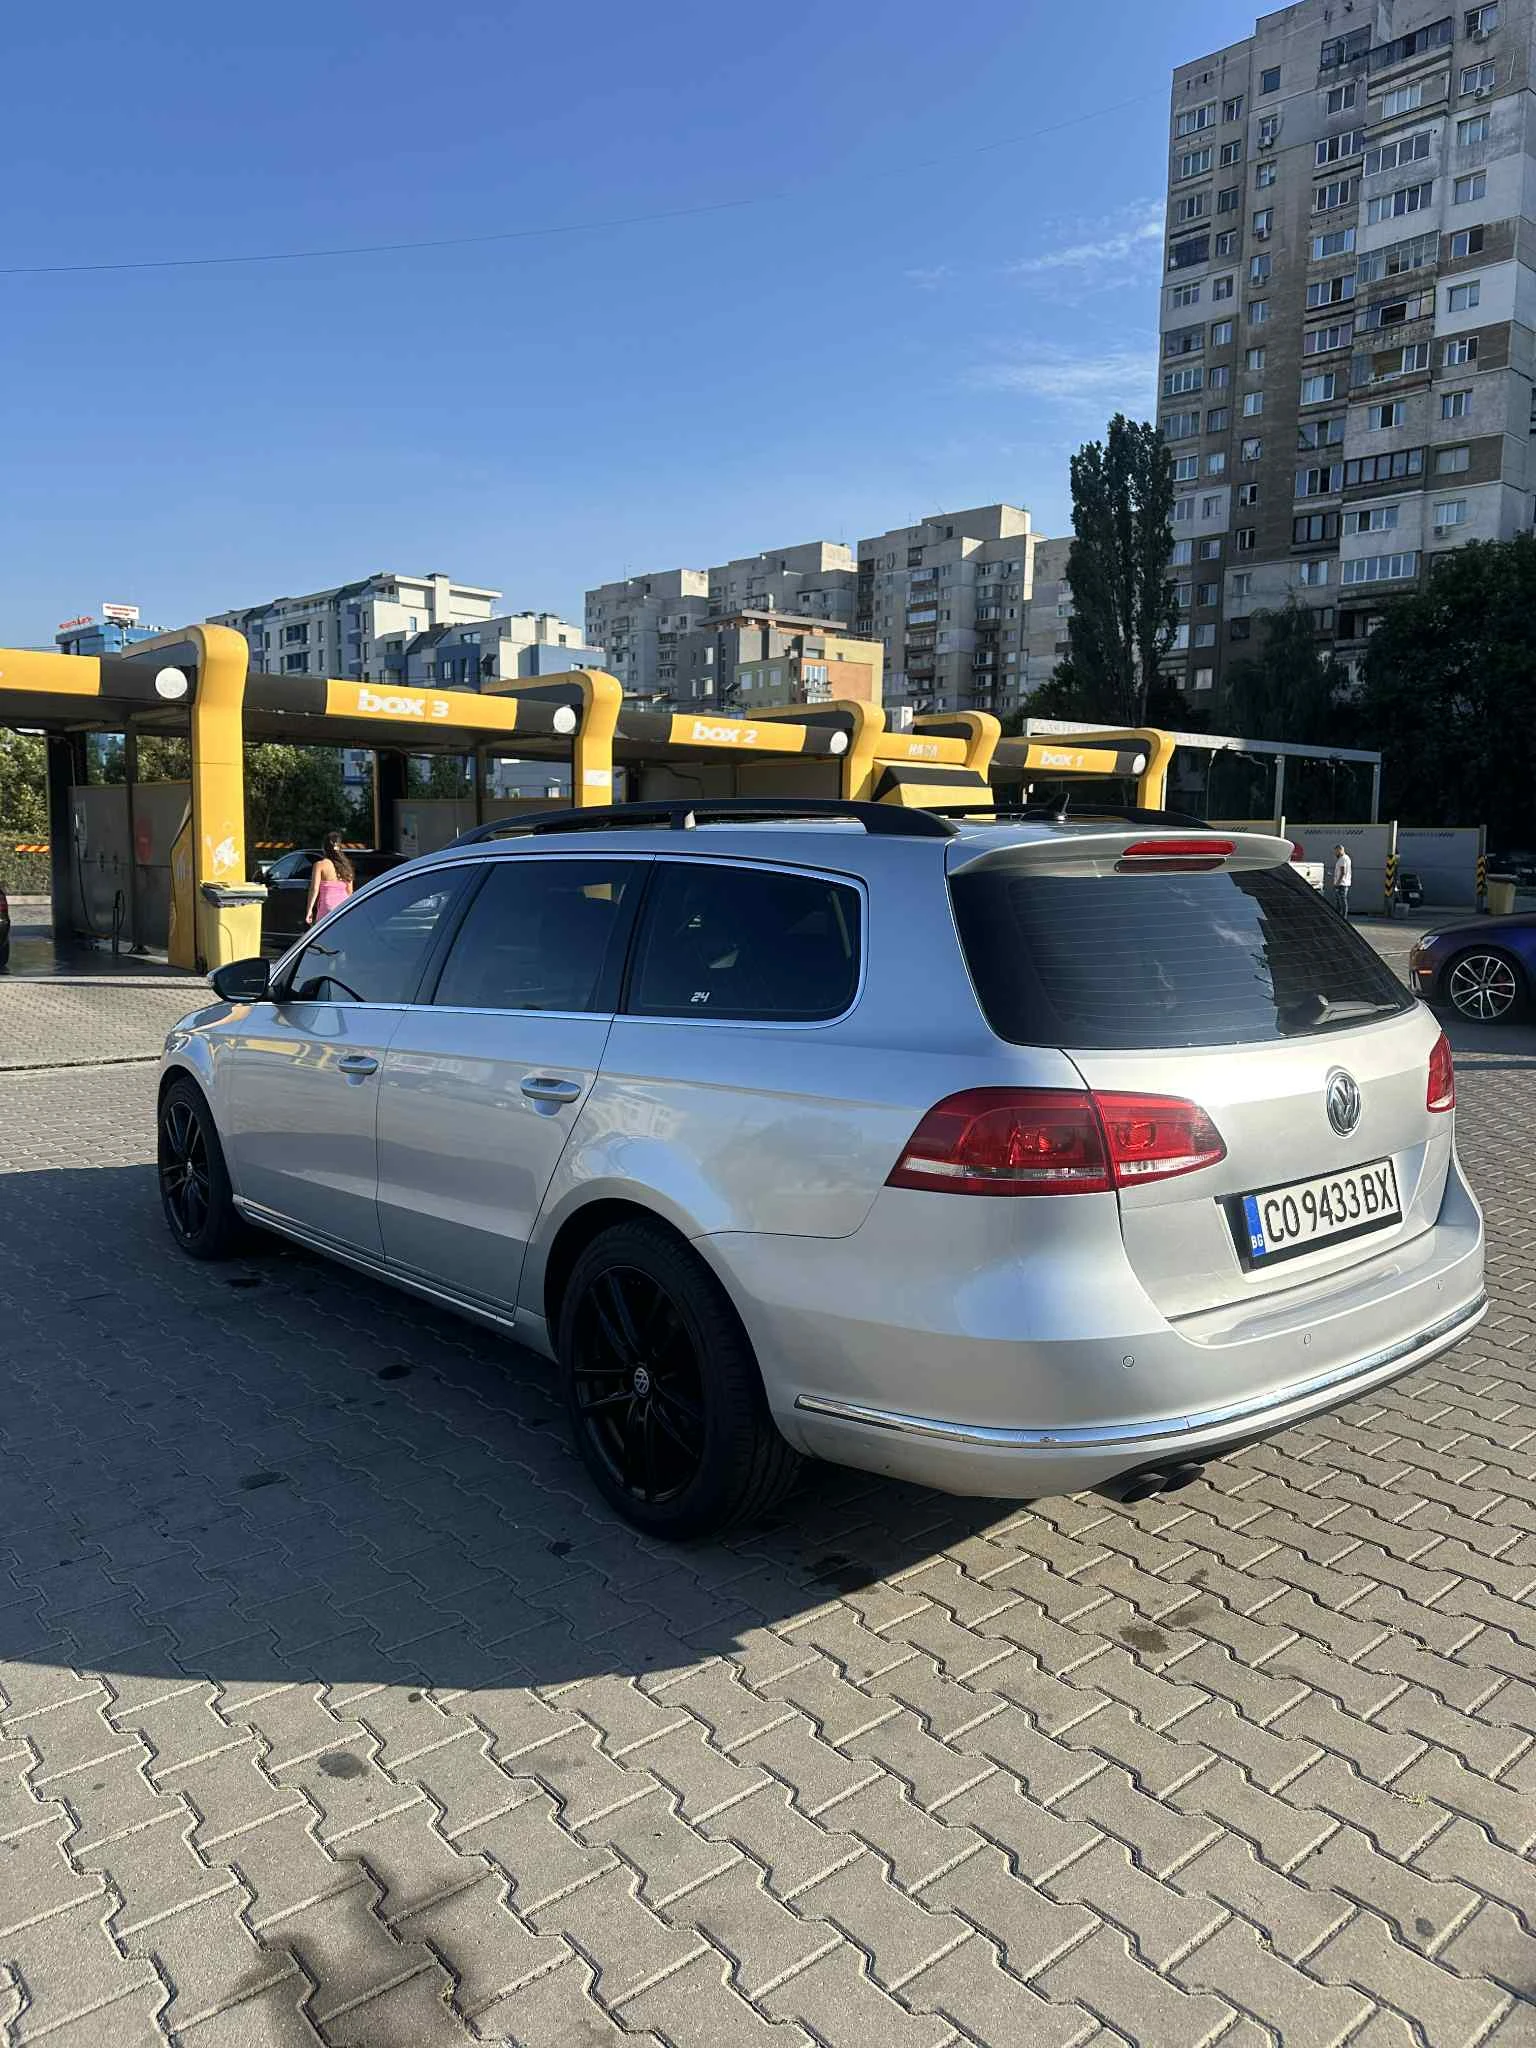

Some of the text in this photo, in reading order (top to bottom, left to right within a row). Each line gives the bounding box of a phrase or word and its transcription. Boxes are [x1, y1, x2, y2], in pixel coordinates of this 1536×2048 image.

[358, 689, 449, 718] box 3
[692, 721, 758, 744] box 2
[1041, 751, 1084, 768] box 1
[690, 991, 711, 1003] 24
[1301, 1178, 1360, 1232] 9433
[1360, 1168, 1394, 1215] BX
[1251, 1233, 1264, 1249] BG
